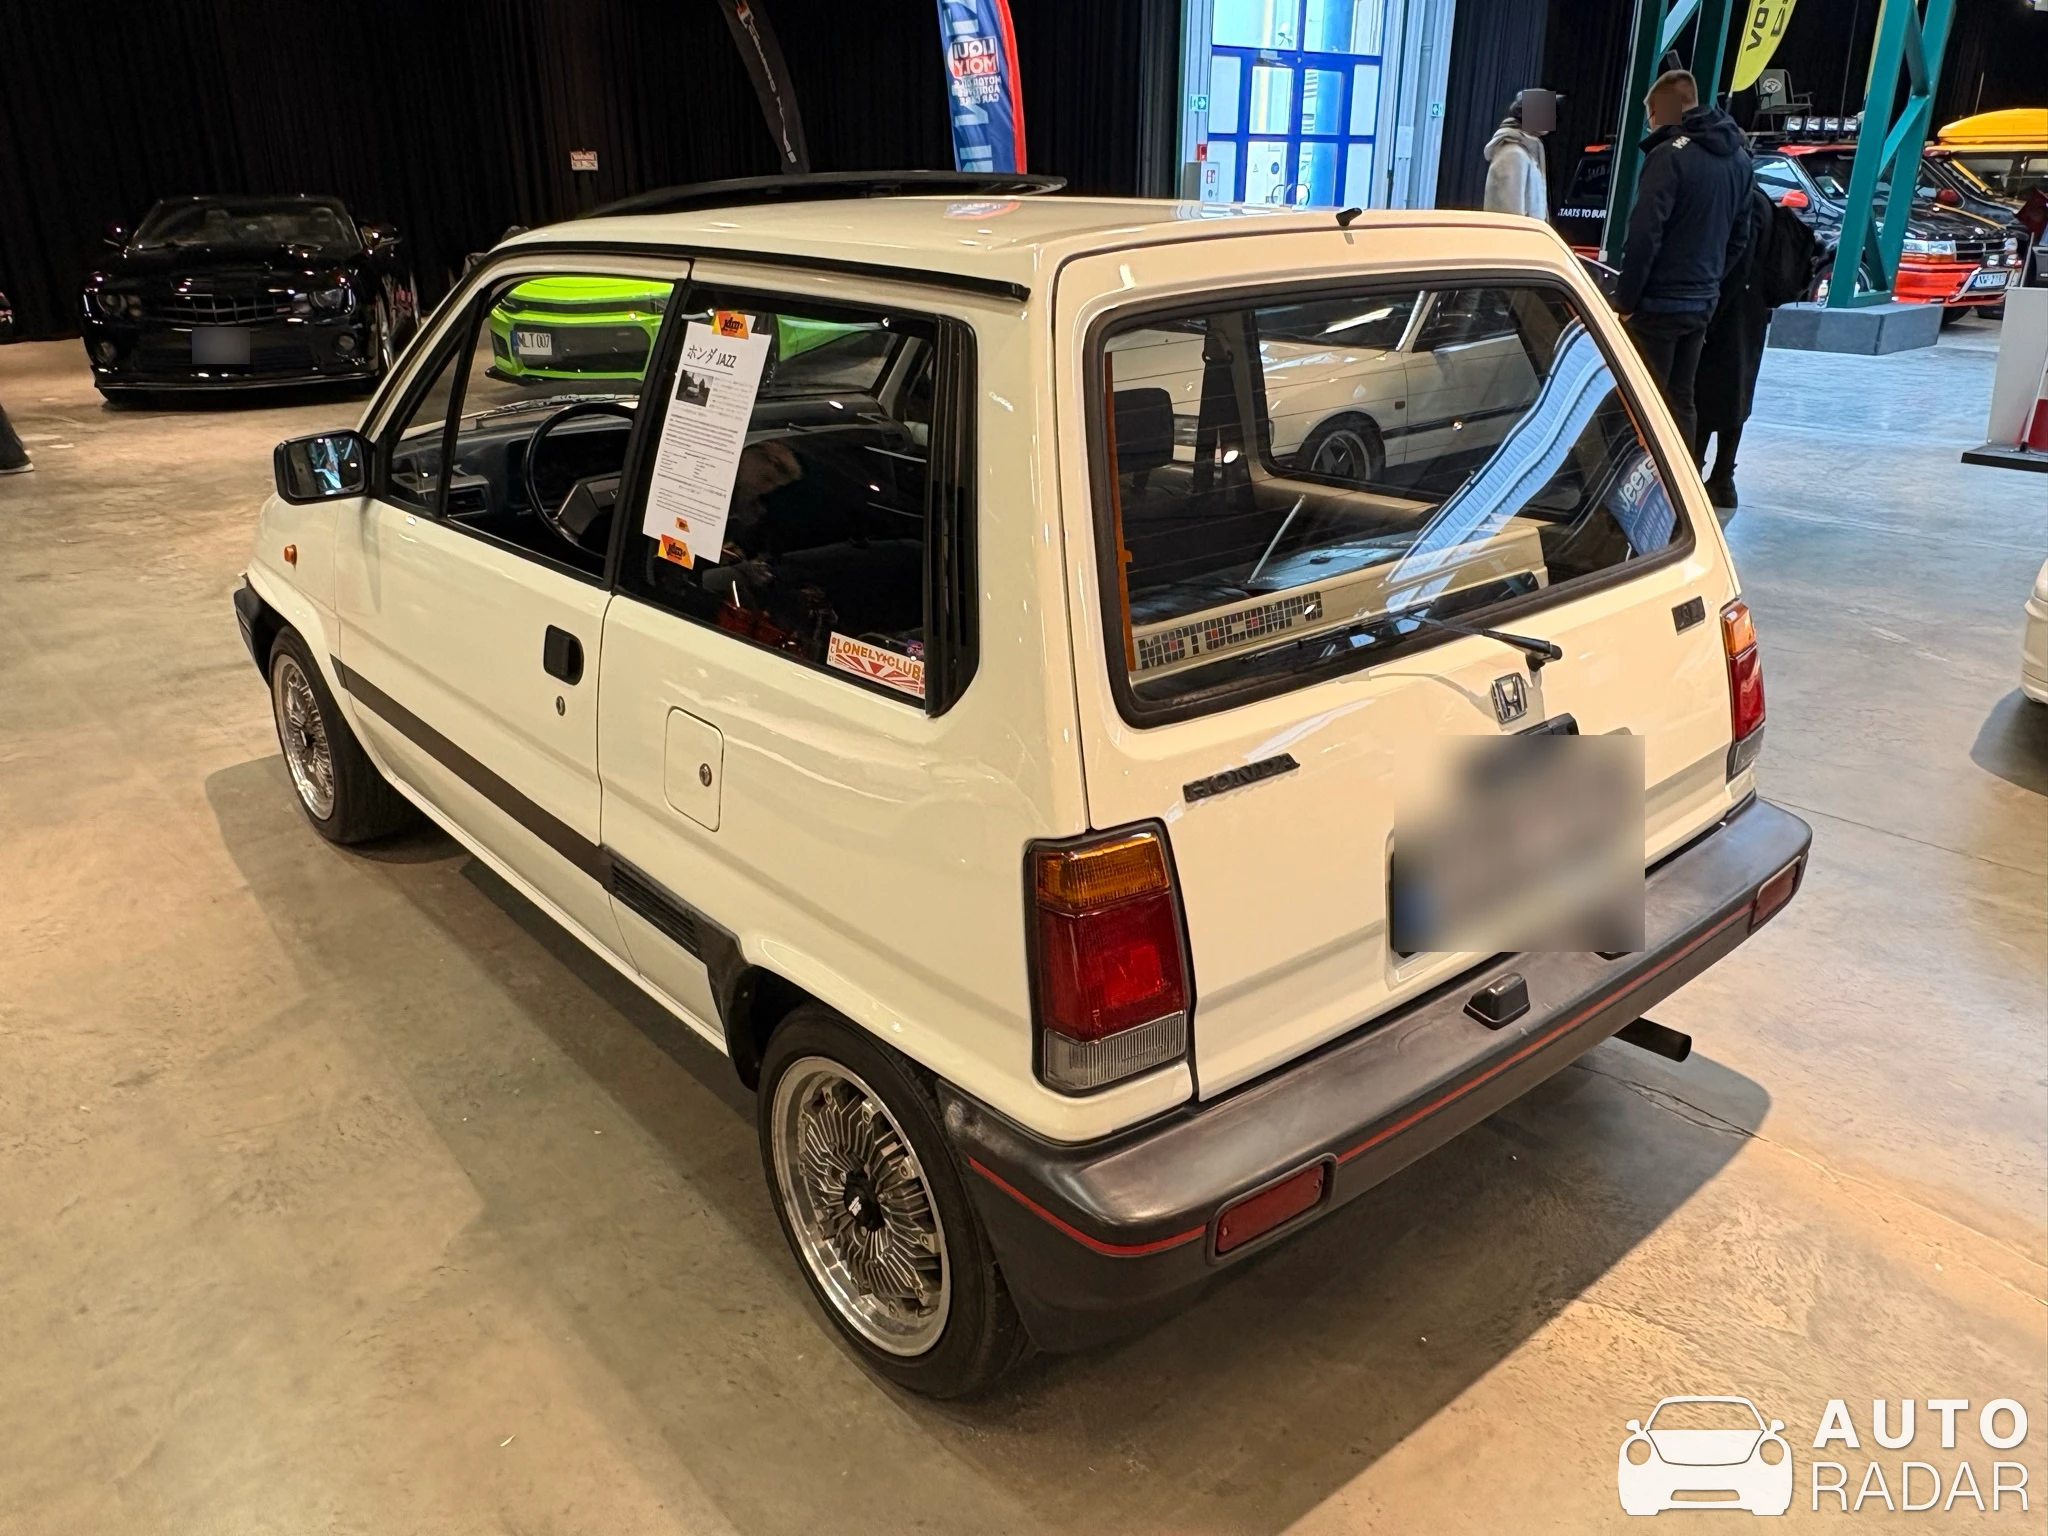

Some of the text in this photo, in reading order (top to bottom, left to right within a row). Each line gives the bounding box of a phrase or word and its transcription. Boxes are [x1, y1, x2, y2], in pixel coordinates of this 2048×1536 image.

[687, 345, 737, 368] ホンダ JAZZ
[1138, 591, 1323, 670] MOTOCOMPO
[836, 638, 883, 662] LONELY
[887, 655, 921, 680] CLUB
